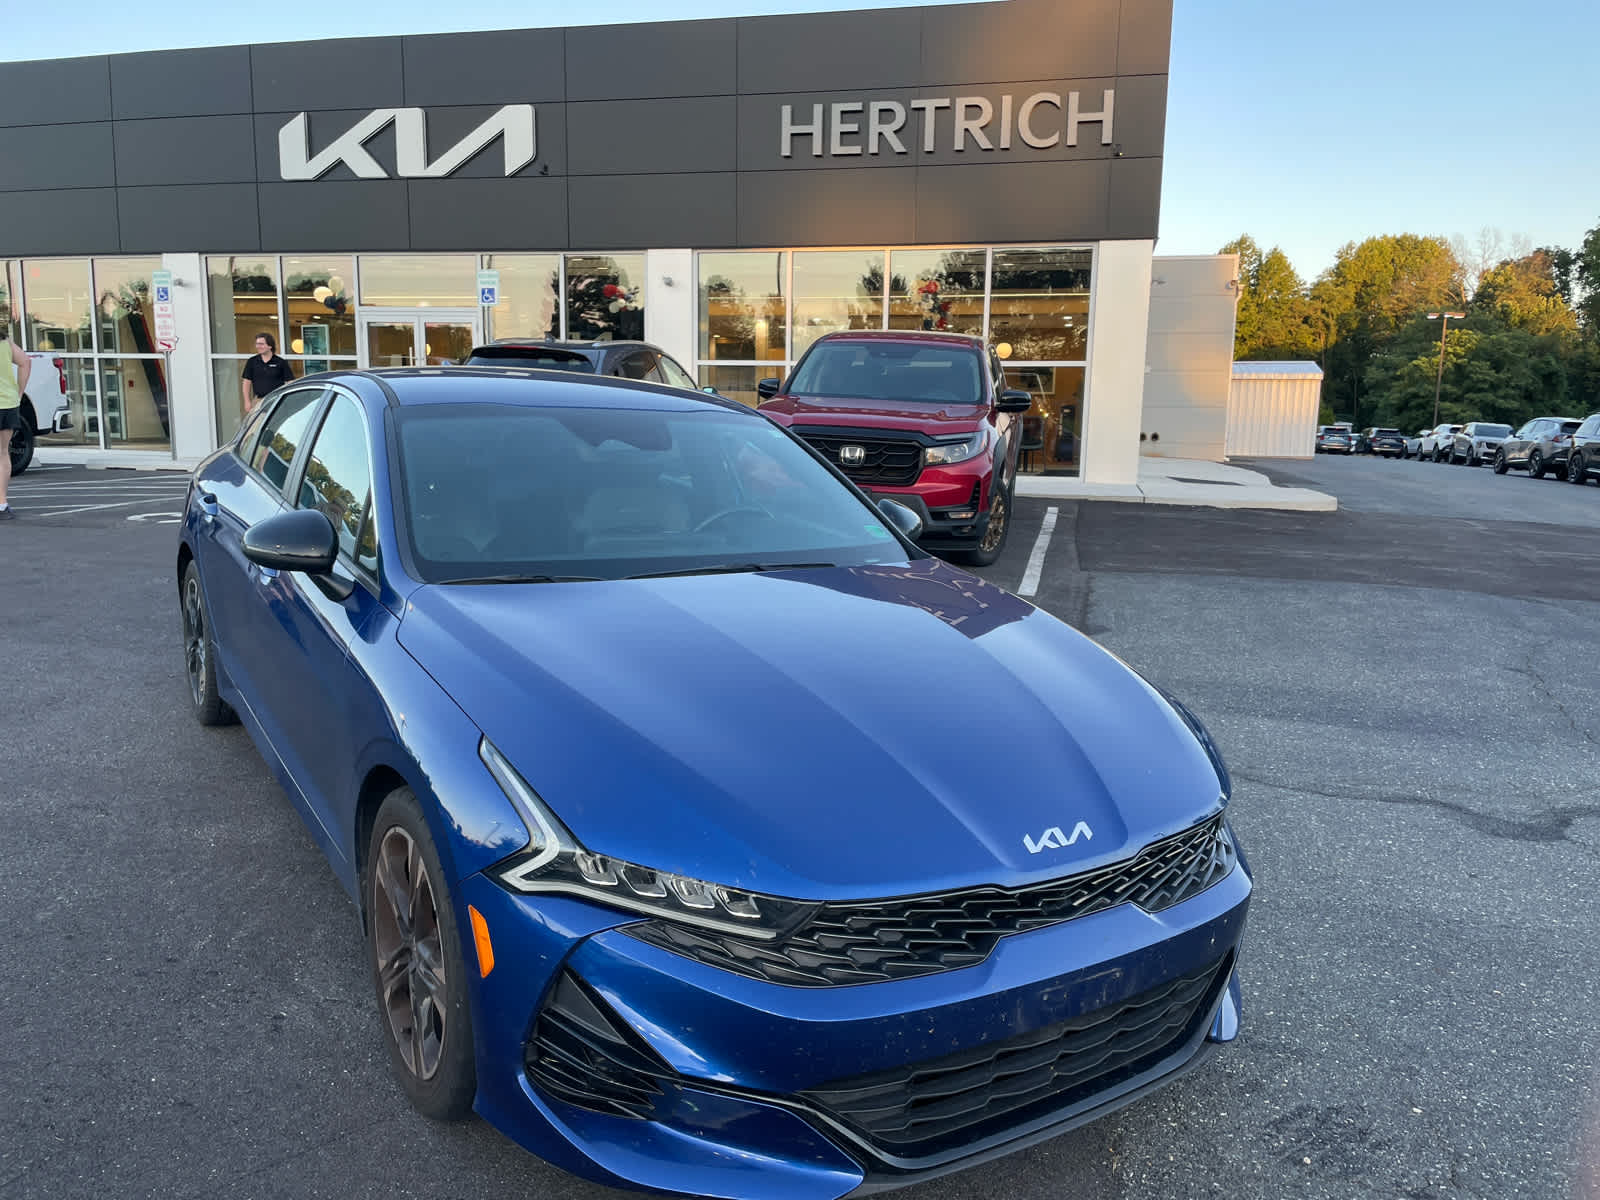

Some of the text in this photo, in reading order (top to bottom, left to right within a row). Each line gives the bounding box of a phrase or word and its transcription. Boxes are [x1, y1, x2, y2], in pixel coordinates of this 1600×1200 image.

[278, 104, 537, 181] KIA
[780, 89, 1115, 157] HERTRICH
[1023, 821, 1093, 854] KIA
